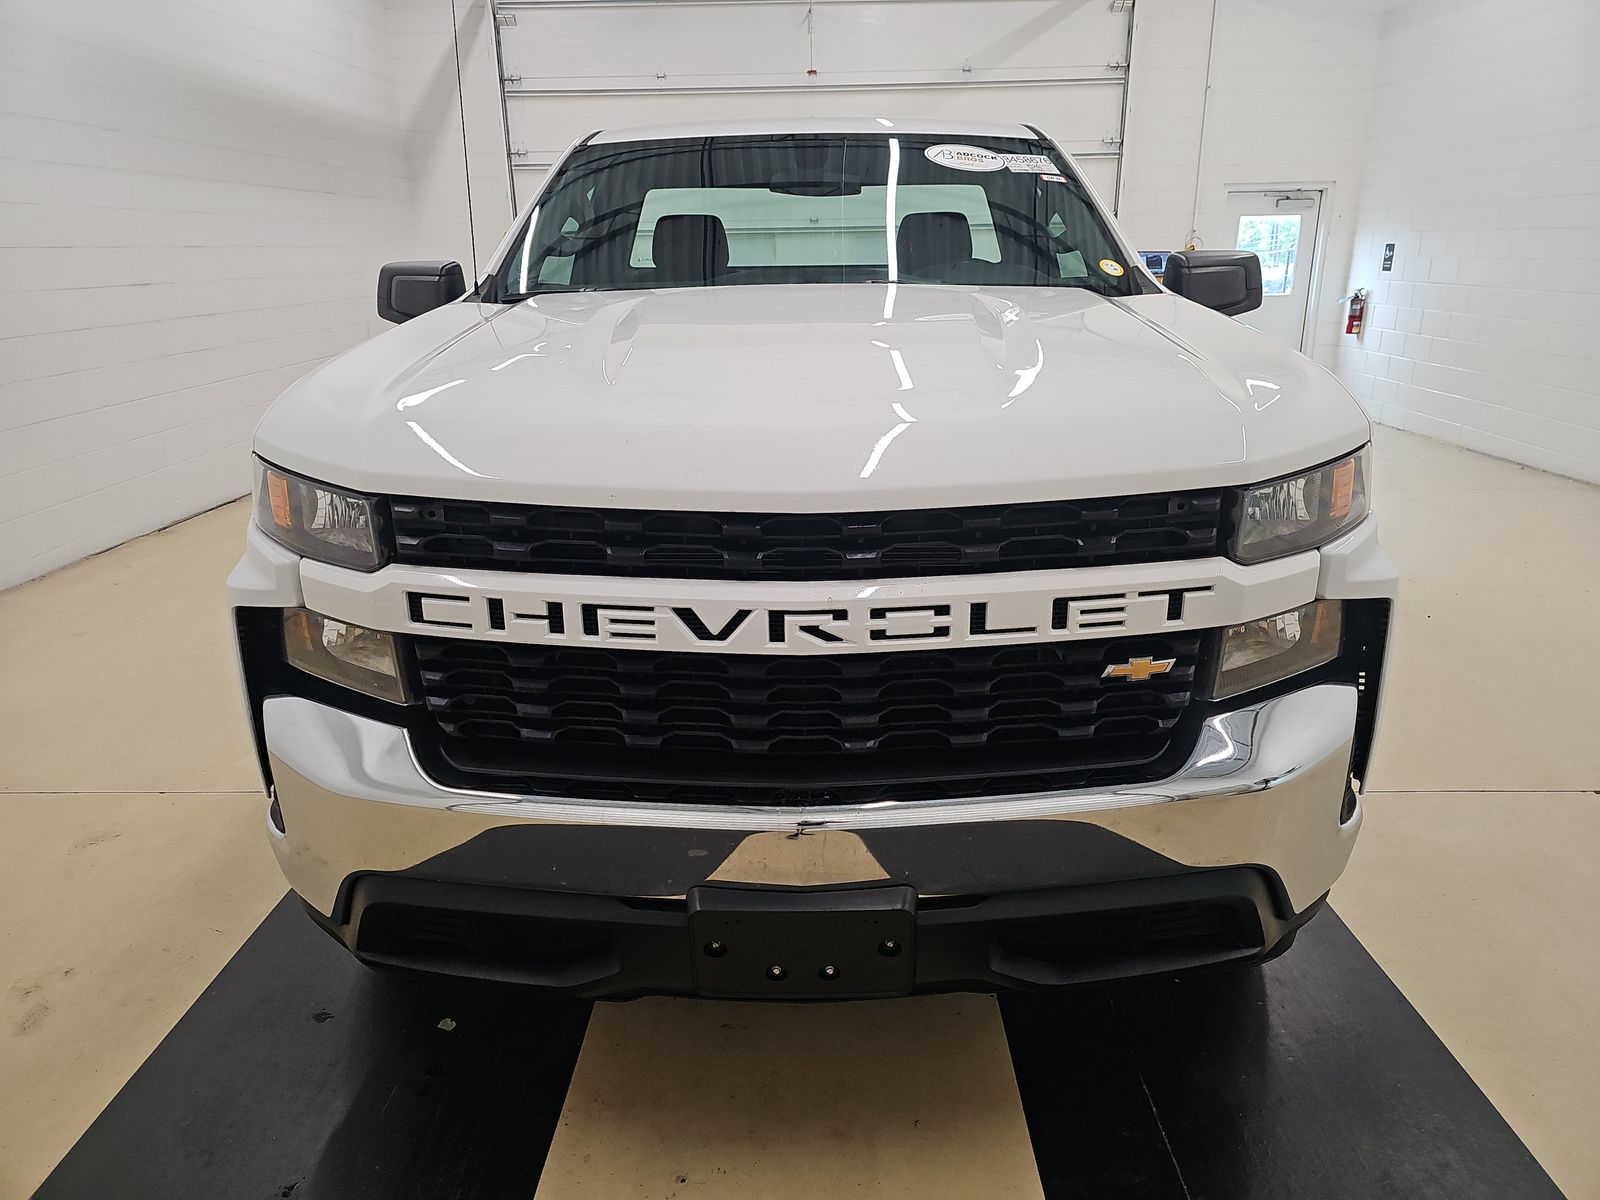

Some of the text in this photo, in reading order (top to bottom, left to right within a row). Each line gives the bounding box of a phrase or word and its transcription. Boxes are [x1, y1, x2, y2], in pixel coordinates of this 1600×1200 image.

[956, 151, 998, 161] ADCOCK
[956, 155, 985, 163] BROS
[403, 585, 1215, 647] CHEVROLET
